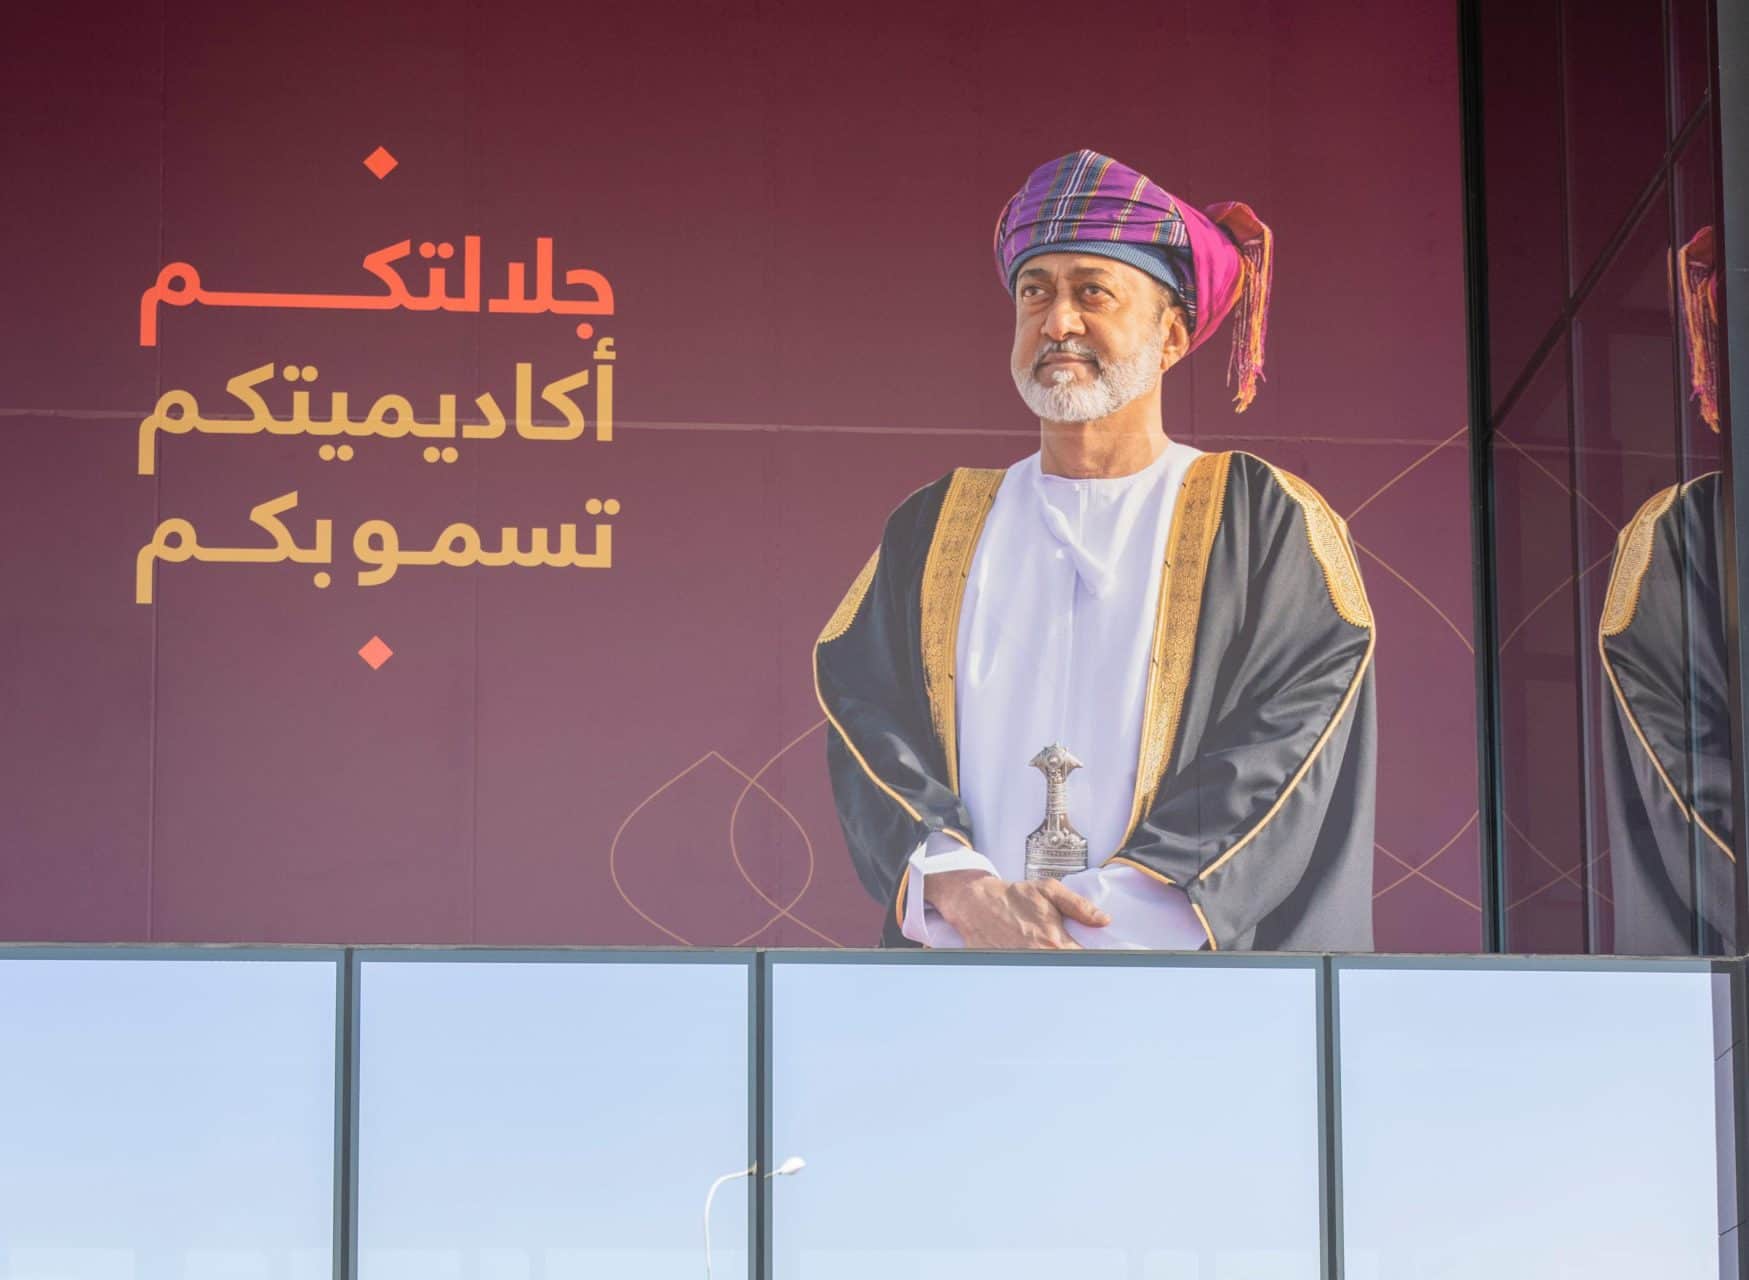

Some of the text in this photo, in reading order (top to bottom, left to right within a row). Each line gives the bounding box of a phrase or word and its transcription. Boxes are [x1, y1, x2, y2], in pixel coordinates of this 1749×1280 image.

[140, 235, 615, 346] جلالتكم
[138, 337, 617, 475] أكاديميتكم
[136, 491, 621, 604] تسمو بكم
